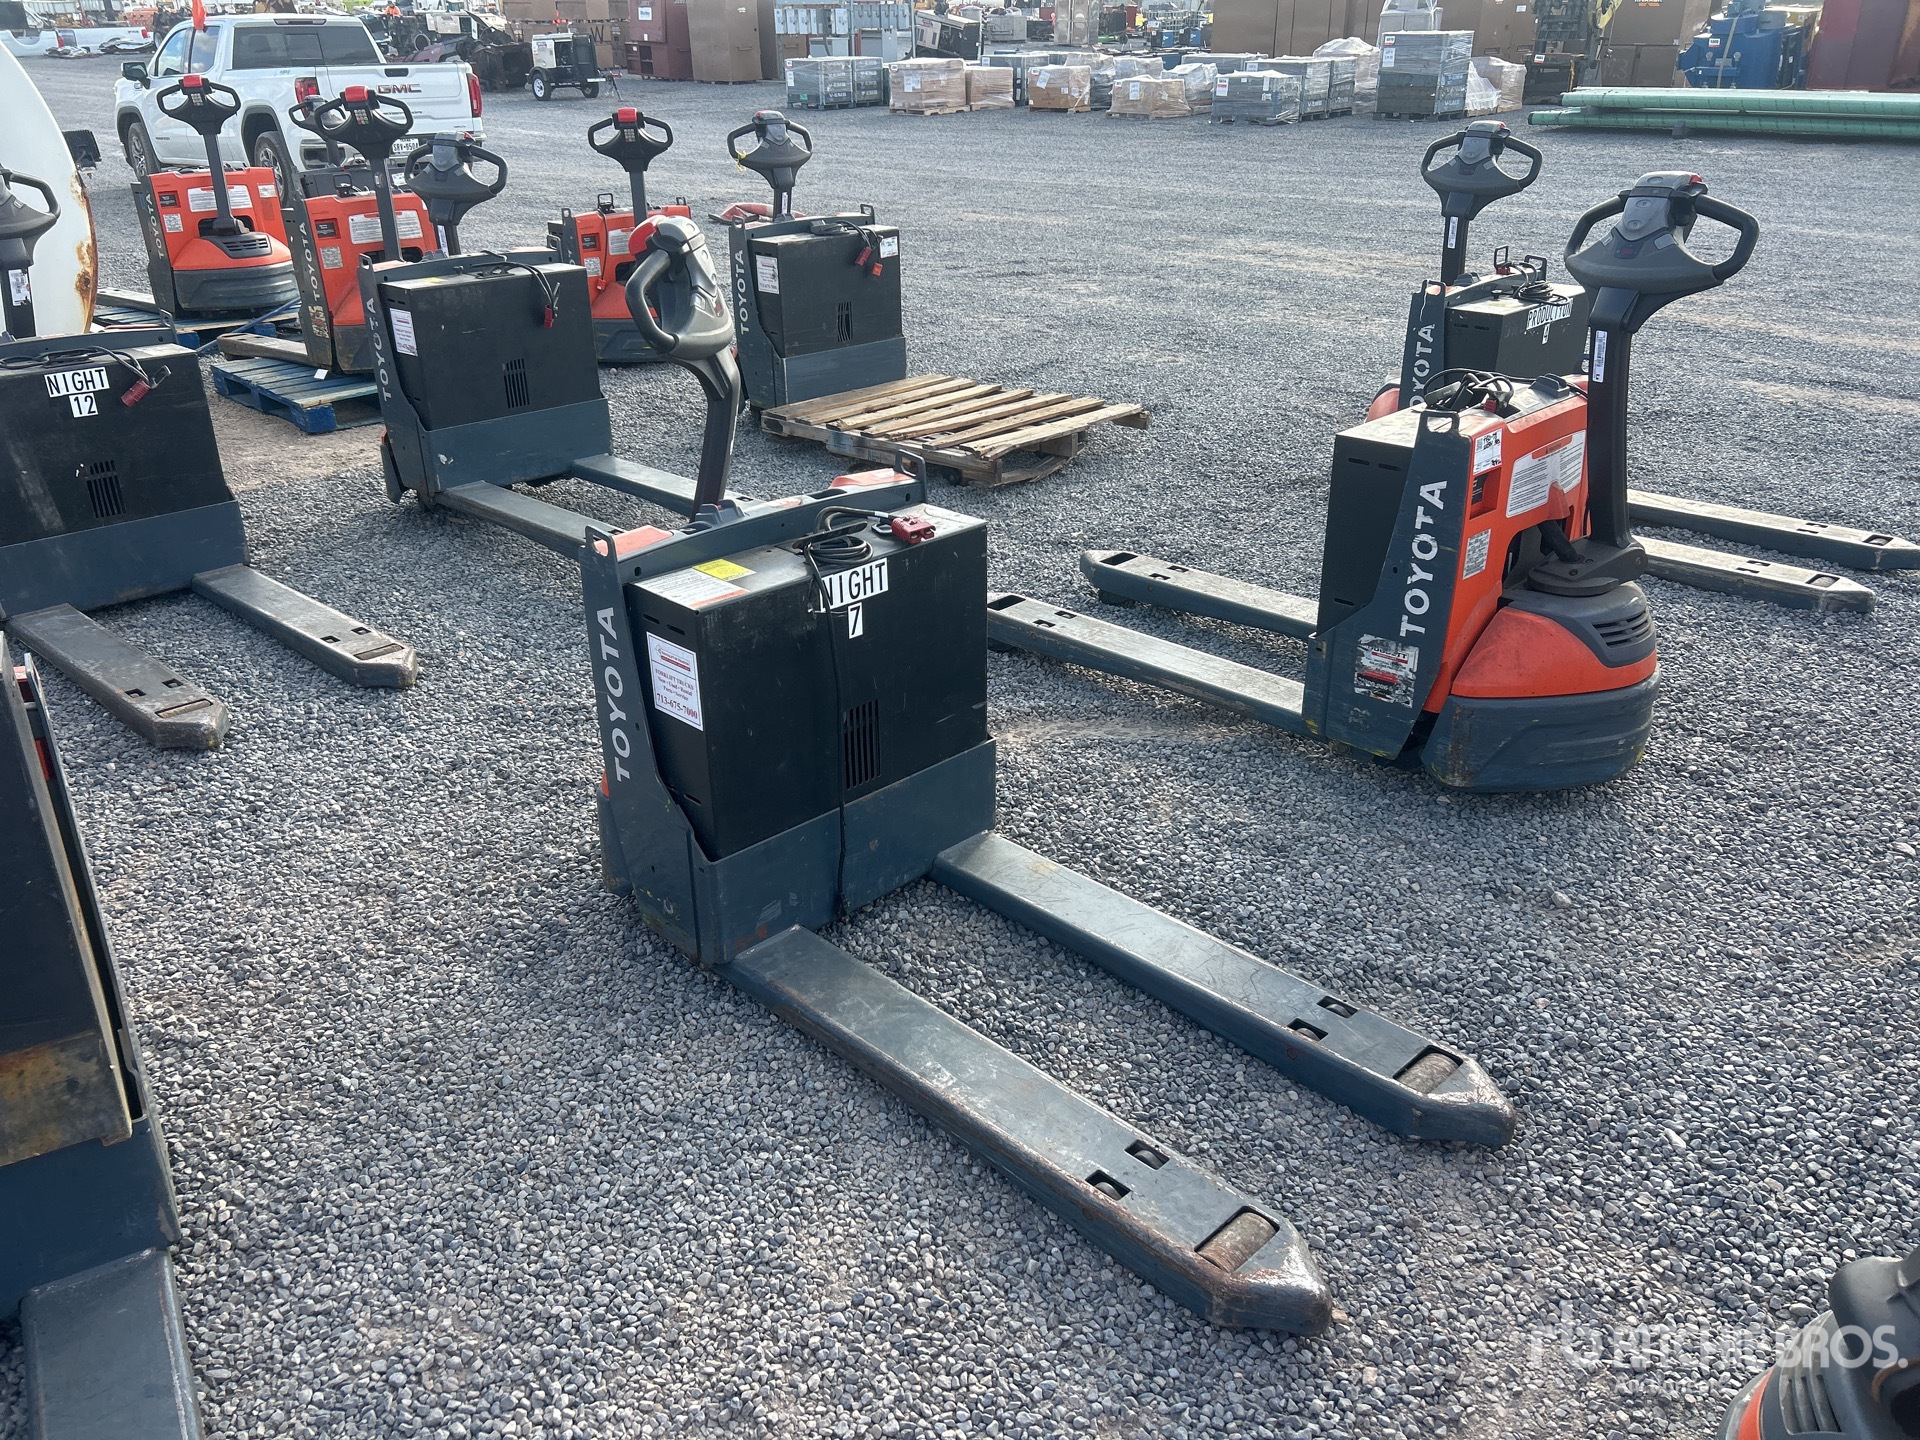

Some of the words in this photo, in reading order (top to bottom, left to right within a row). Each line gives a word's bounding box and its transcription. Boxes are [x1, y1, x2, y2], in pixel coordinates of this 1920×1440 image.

[377, 83, 422, 94] GMC
[146, 193, 165, 260] TOYOTA
[298, 222, 321, 302] TOYOTA
[738, 250, 752, 335] TOYOTA
[366, 298, 392, 402] TOYOTA
[49, 369, 108, 395] NIGHT
[74, 395, 96, 416] 12
[822, 563, 886, 606] NIGHT
[1400, 479, 1448, 637] TOYOTA
[850, 605, 861, 636] 7
[596, 607, 632, 783] TOYOTA
[656, 693, 698, 719] 713-675-7000
